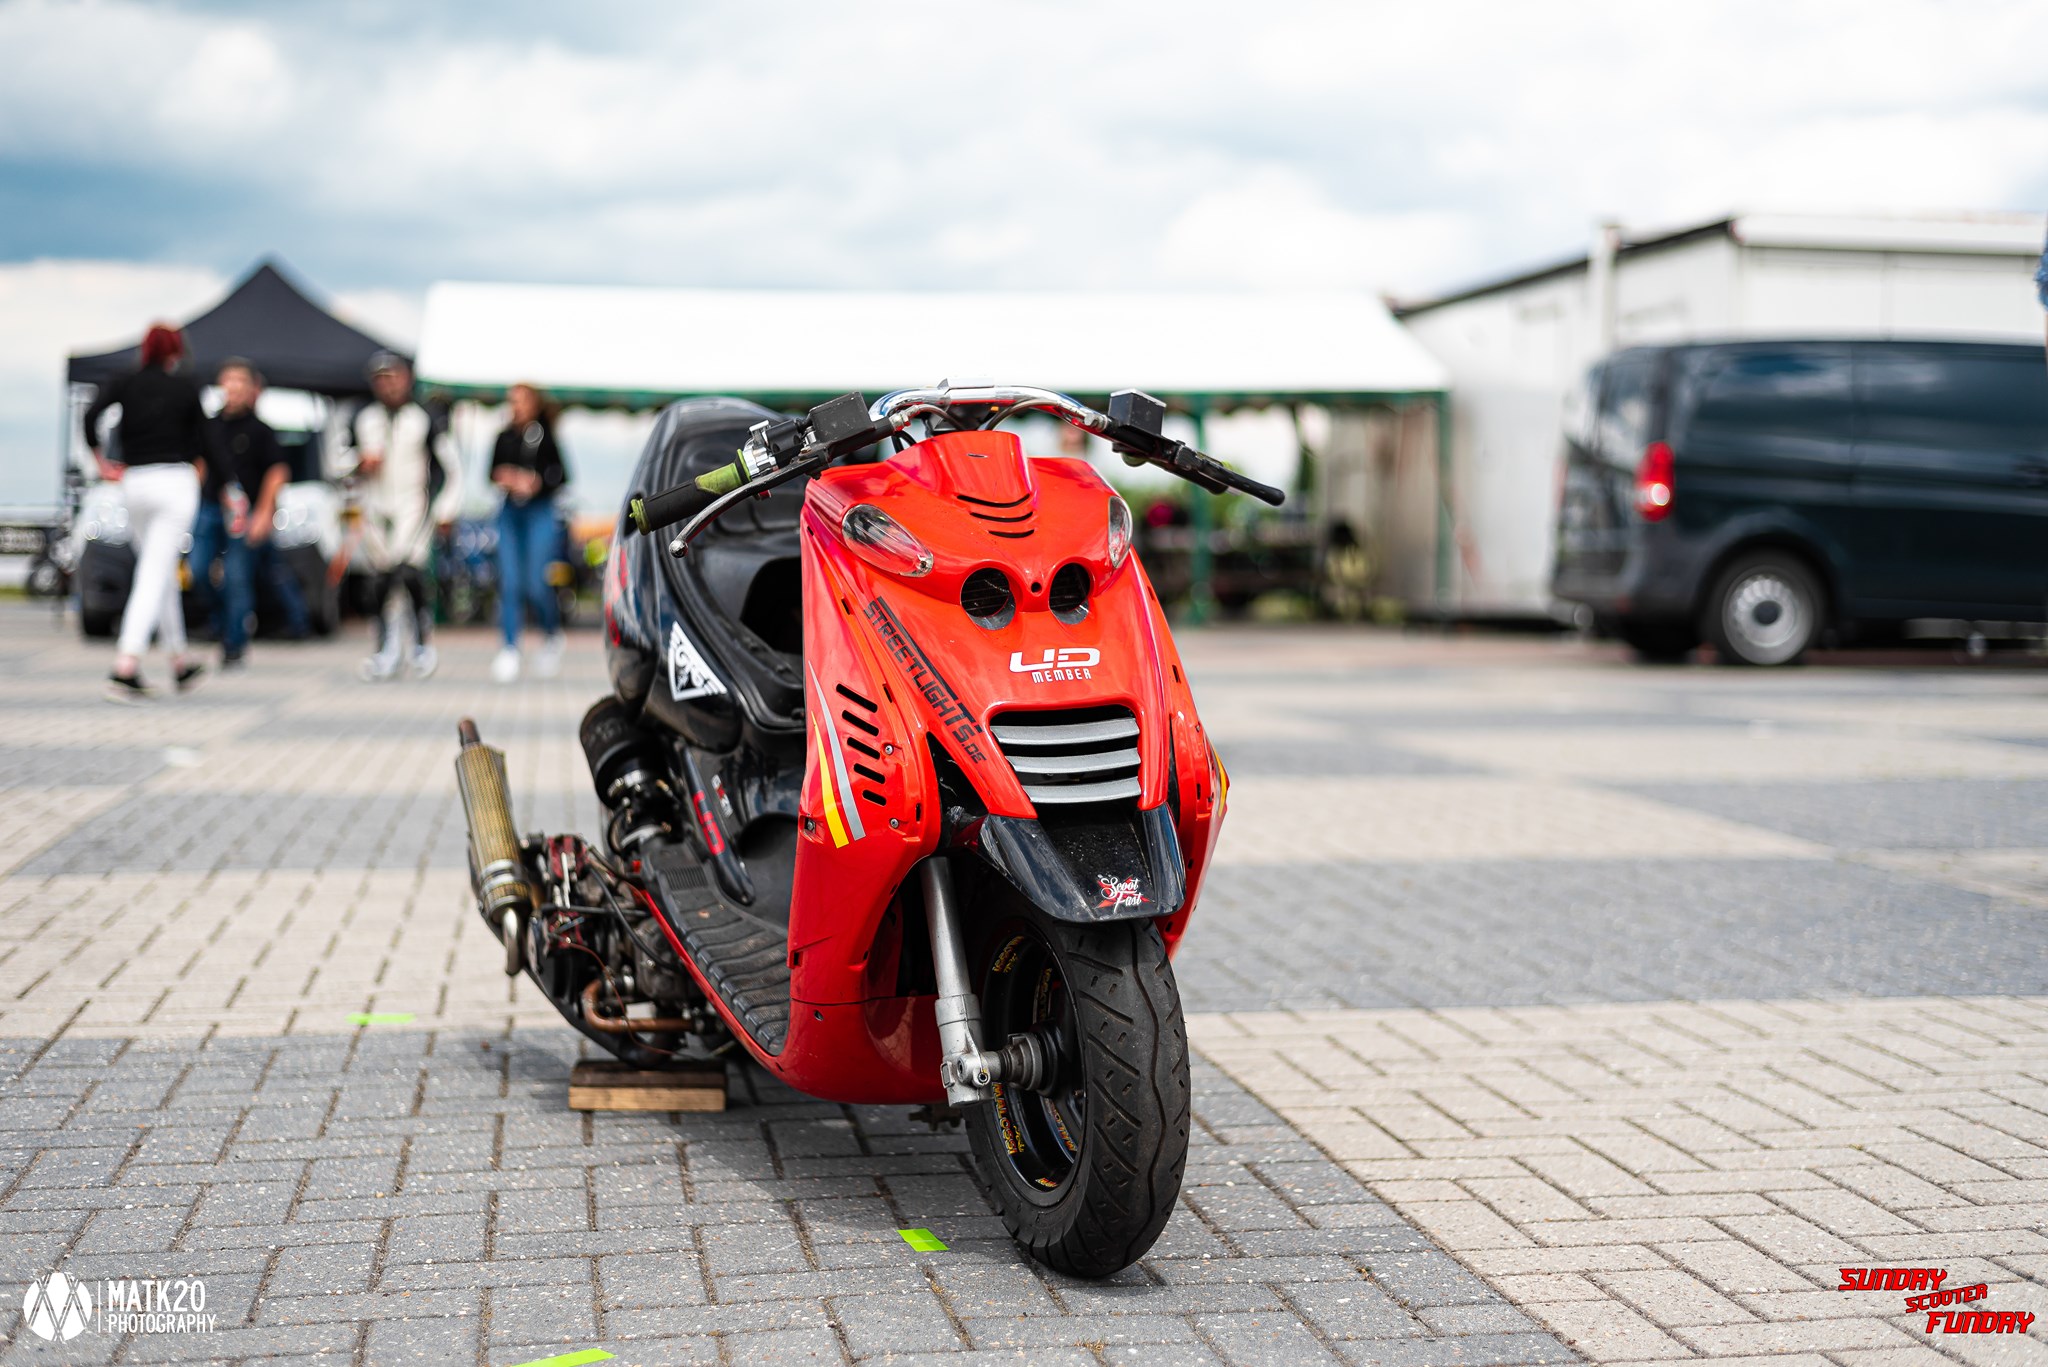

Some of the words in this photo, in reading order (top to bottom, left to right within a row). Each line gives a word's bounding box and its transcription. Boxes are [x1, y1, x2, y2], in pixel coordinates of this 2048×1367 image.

[863, 597, 987, 764] STREETLIGHTS.DE
[1031, 668, 1092, 684] MEMBER
[1100, 876, 1140, 900] Scoot
[1113, 891, 1144, 914] Fast
[992, 1081, 1018, 1156] MALOSSI
